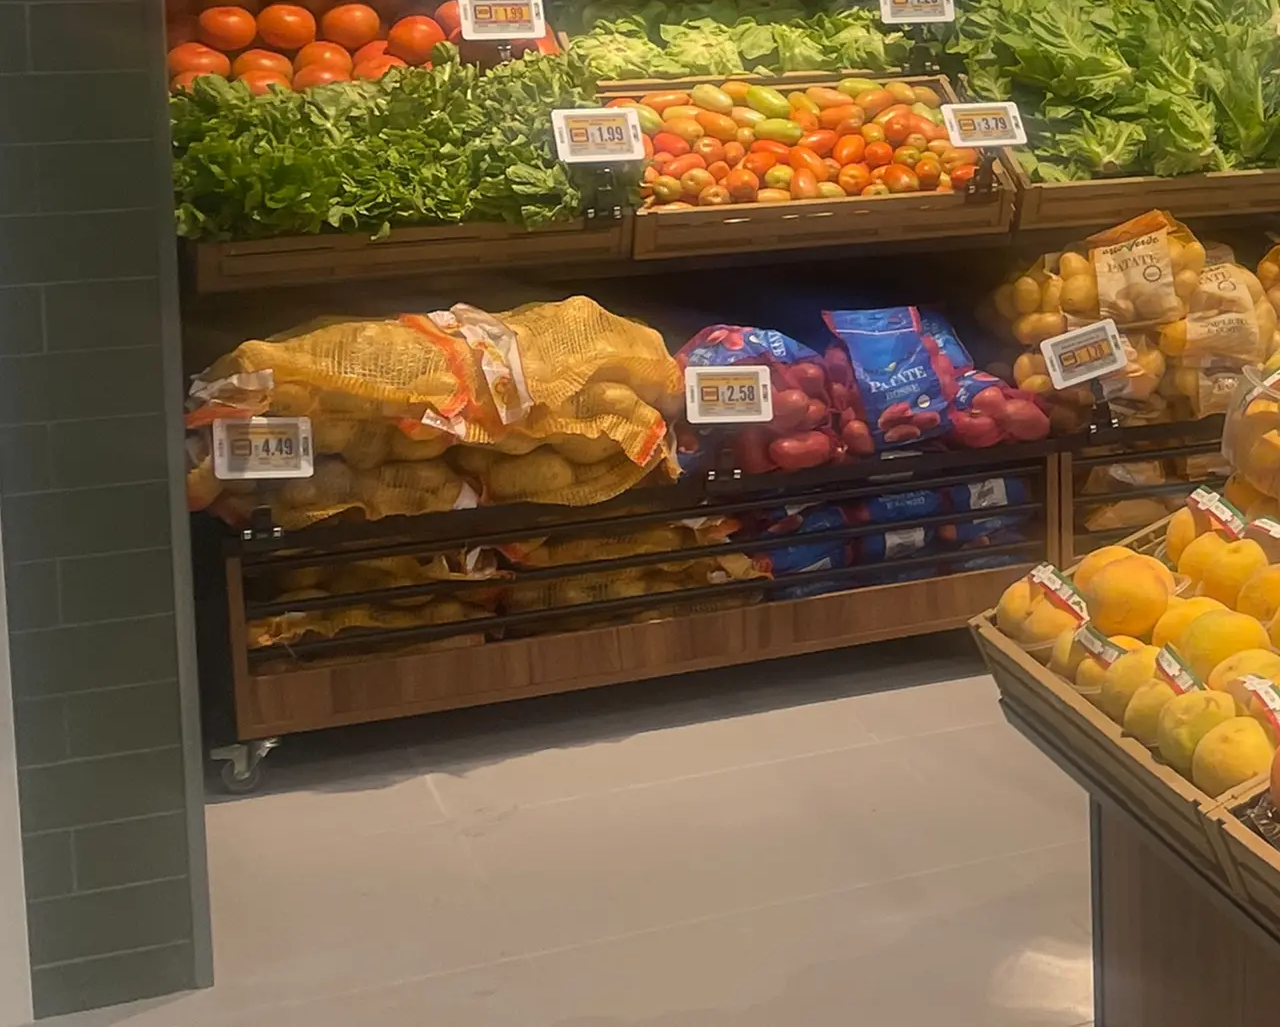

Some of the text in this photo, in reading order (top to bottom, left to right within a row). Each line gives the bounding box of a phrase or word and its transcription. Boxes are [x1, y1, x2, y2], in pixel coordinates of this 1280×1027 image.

[503, 7, 524, 20] 1.99
[983, 116, 1007, 130] 3.79
[598, 127, 623, 142] 1.99
[1106, 252, 1160, 273] PATATE
[869, 366, 927, 393] PATATE
[727, 387, 755, 402] 2.58
[262, 439, 293, 456] 4.49
